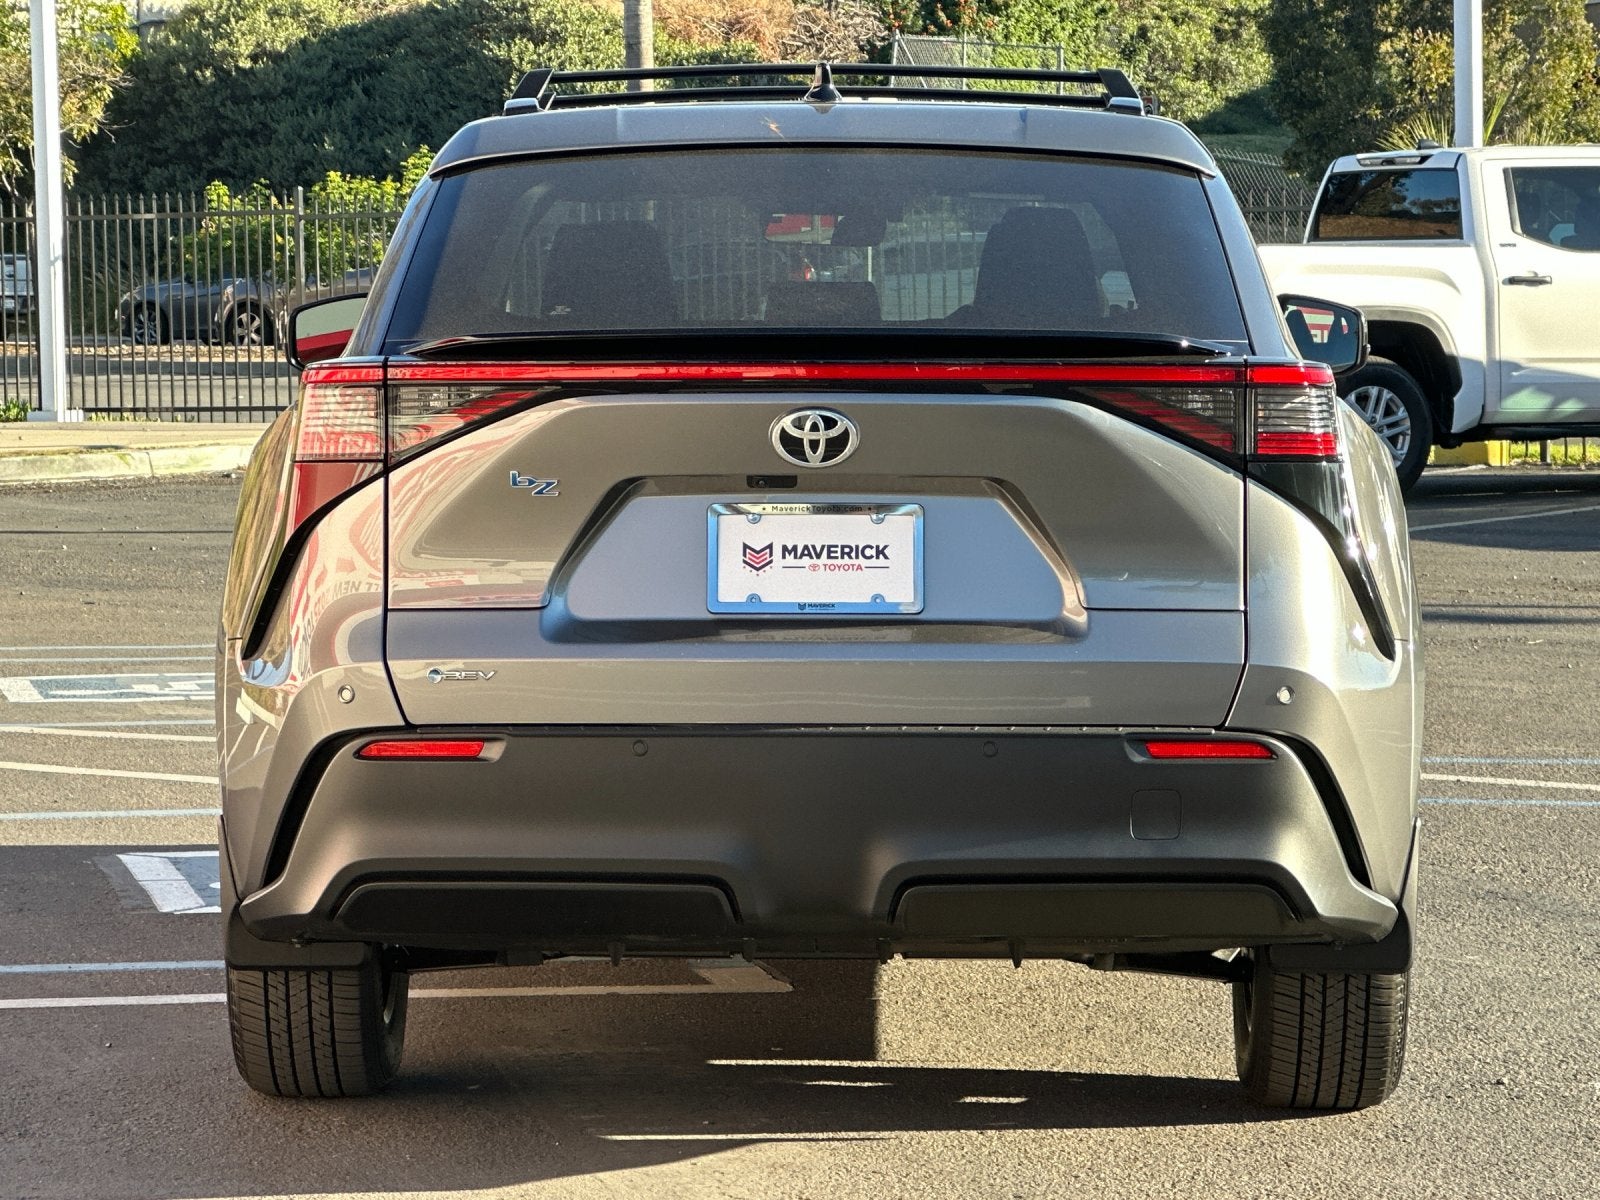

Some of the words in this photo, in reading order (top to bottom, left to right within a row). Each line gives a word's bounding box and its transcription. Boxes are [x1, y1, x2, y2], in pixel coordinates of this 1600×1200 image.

[771, 504, 863, 514] MaverickToyota.com
[781, 544, 890, 560] MAVERICK
[823, 563, 863, 572] TOYOTA
[443, 670, 497, 681] BEV
